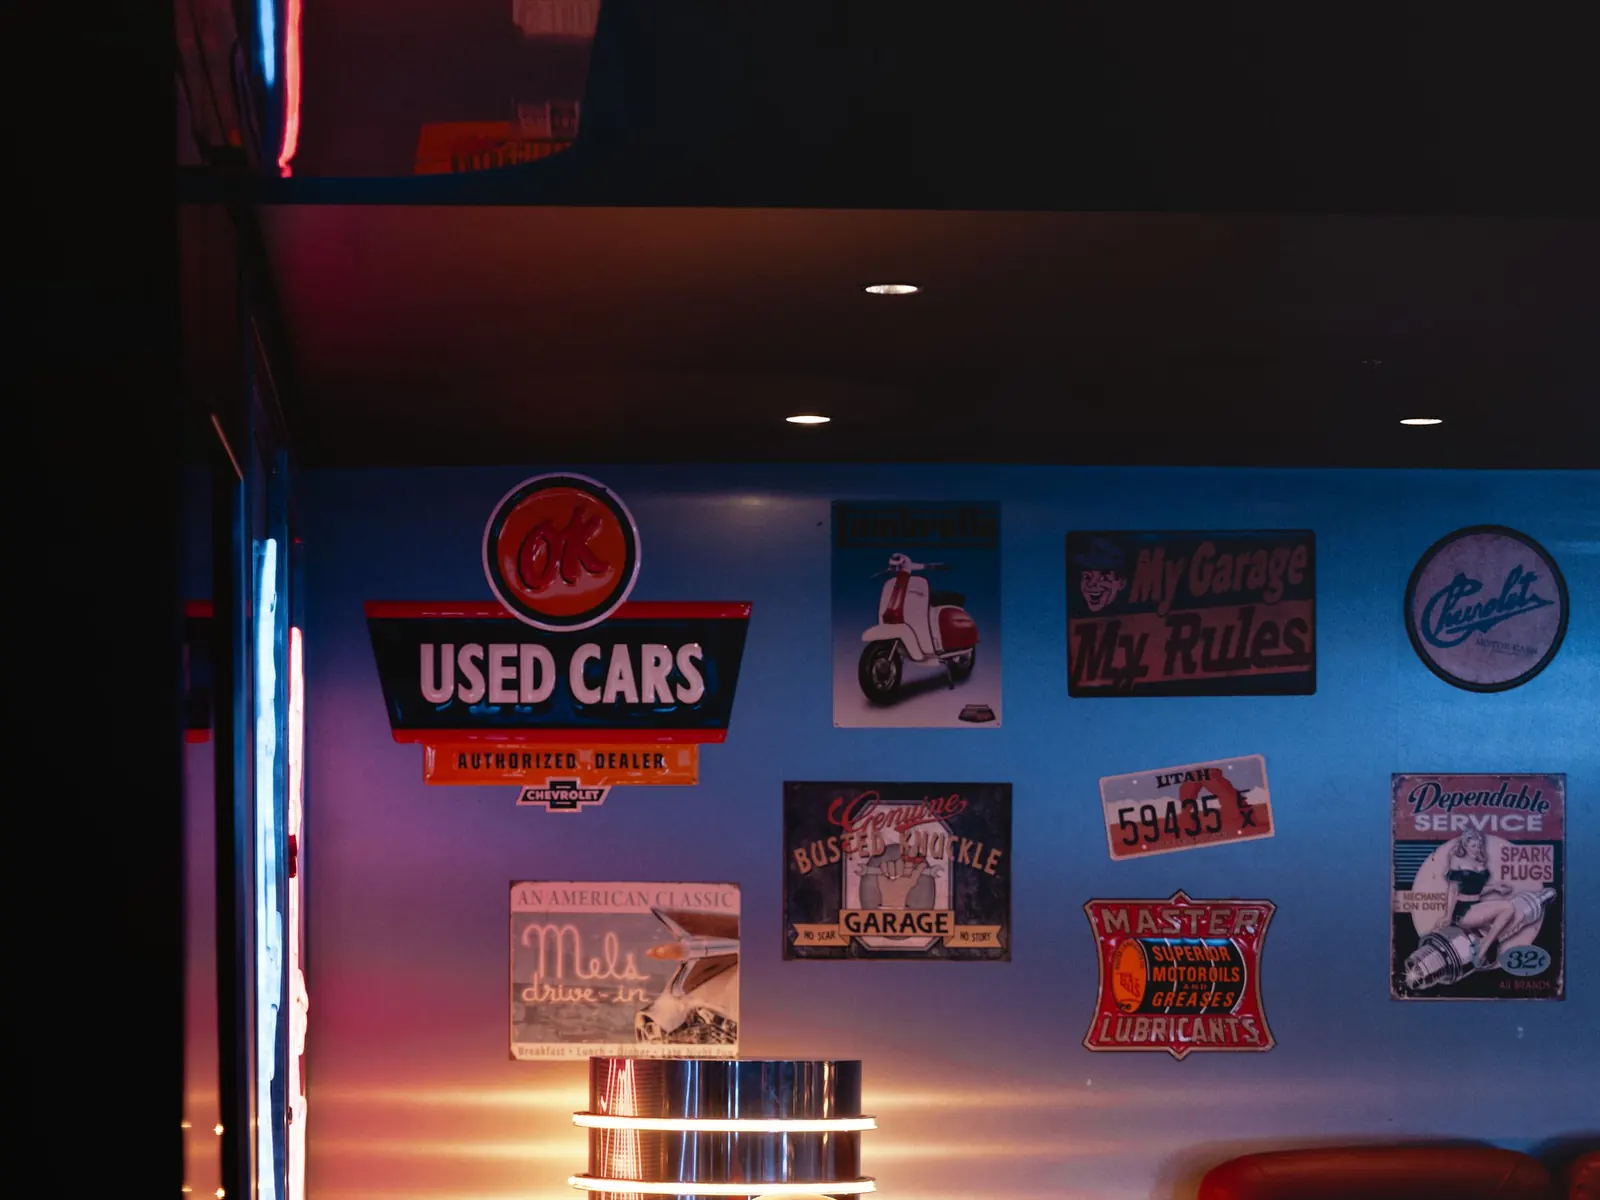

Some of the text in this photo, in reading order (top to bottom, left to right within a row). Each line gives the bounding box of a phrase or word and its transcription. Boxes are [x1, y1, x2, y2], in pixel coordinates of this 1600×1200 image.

[518, 504, 613, 591] OK
[1127, 540, 1308, 617] My Garage
[1070, 605, 1314, 691] My Rules
[419, 642, 705, 705] USED CARS
[458, 752, 664, 769] AUTHORIZED DEALER
[1155, 769, 1211, 789] UTAH
[526, 789, 600, 801] CHEVROLET
[1408, 782, 1550, 815] Dependable
[828, 790, 968, 833] Genuine
[1118, 795, 1222, 846] 59435
[1414, 814, 1543, 832] SERVICE
[793, 831, 1002, 876] BUSTED KNUCKLE
[1500, 846, 1552, 863] SPARK
[1500, 865, 1553, 881] PLUGS
[518, 890, 545, 906] AN
[547, 890, 650, 907] AMERICAN
[1403, 892, 1446, 901] MECHANIC
[1403, 902, 1447, 911] ON DUTY
[845, 912, 949, 934] GARAGE
[1100, 908, 1260, 936] MASTER
[804, 931, 814, 940] NO
[960, 931, 992, 942] NO STORY
[1152, 945, 1232, 962] SUPERIOR
[521, 972, 650, 1005] drive-in
[1151, 991, 1236, 1009] GREASES
[1099, 1015, 1258, 1045] LUBRICANTS
